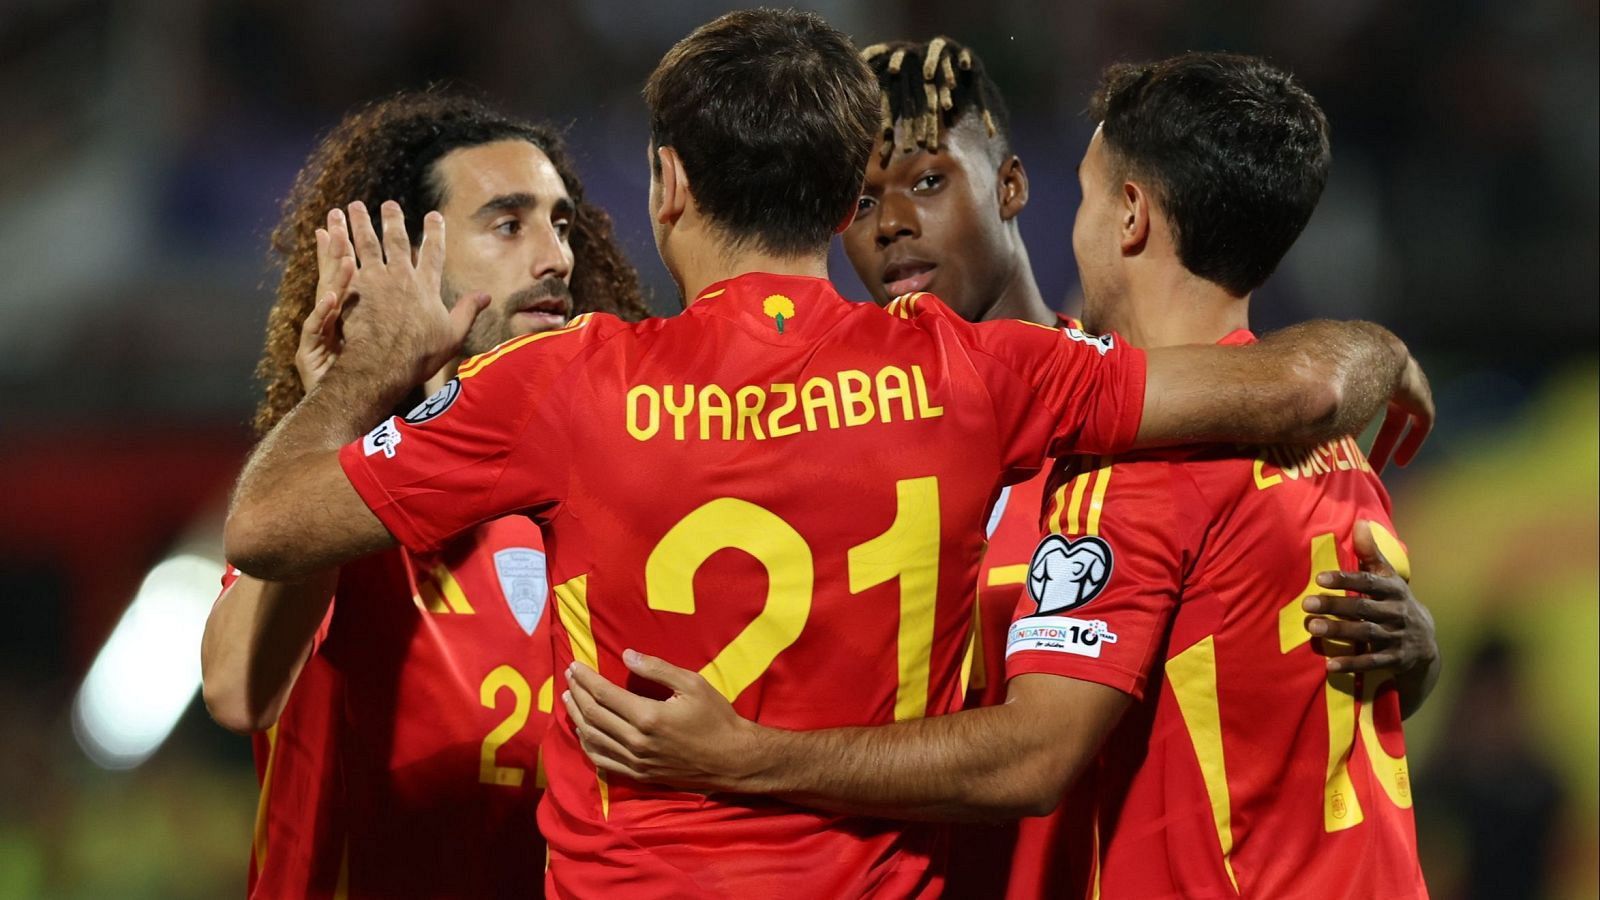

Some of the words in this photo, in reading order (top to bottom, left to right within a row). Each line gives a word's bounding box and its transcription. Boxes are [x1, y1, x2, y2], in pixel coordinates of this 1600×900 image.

[625, 364, 944, 441] OYARZABAL
[645, 475, 941, 723] 21
[1069, 625, 1099, 646] 10
